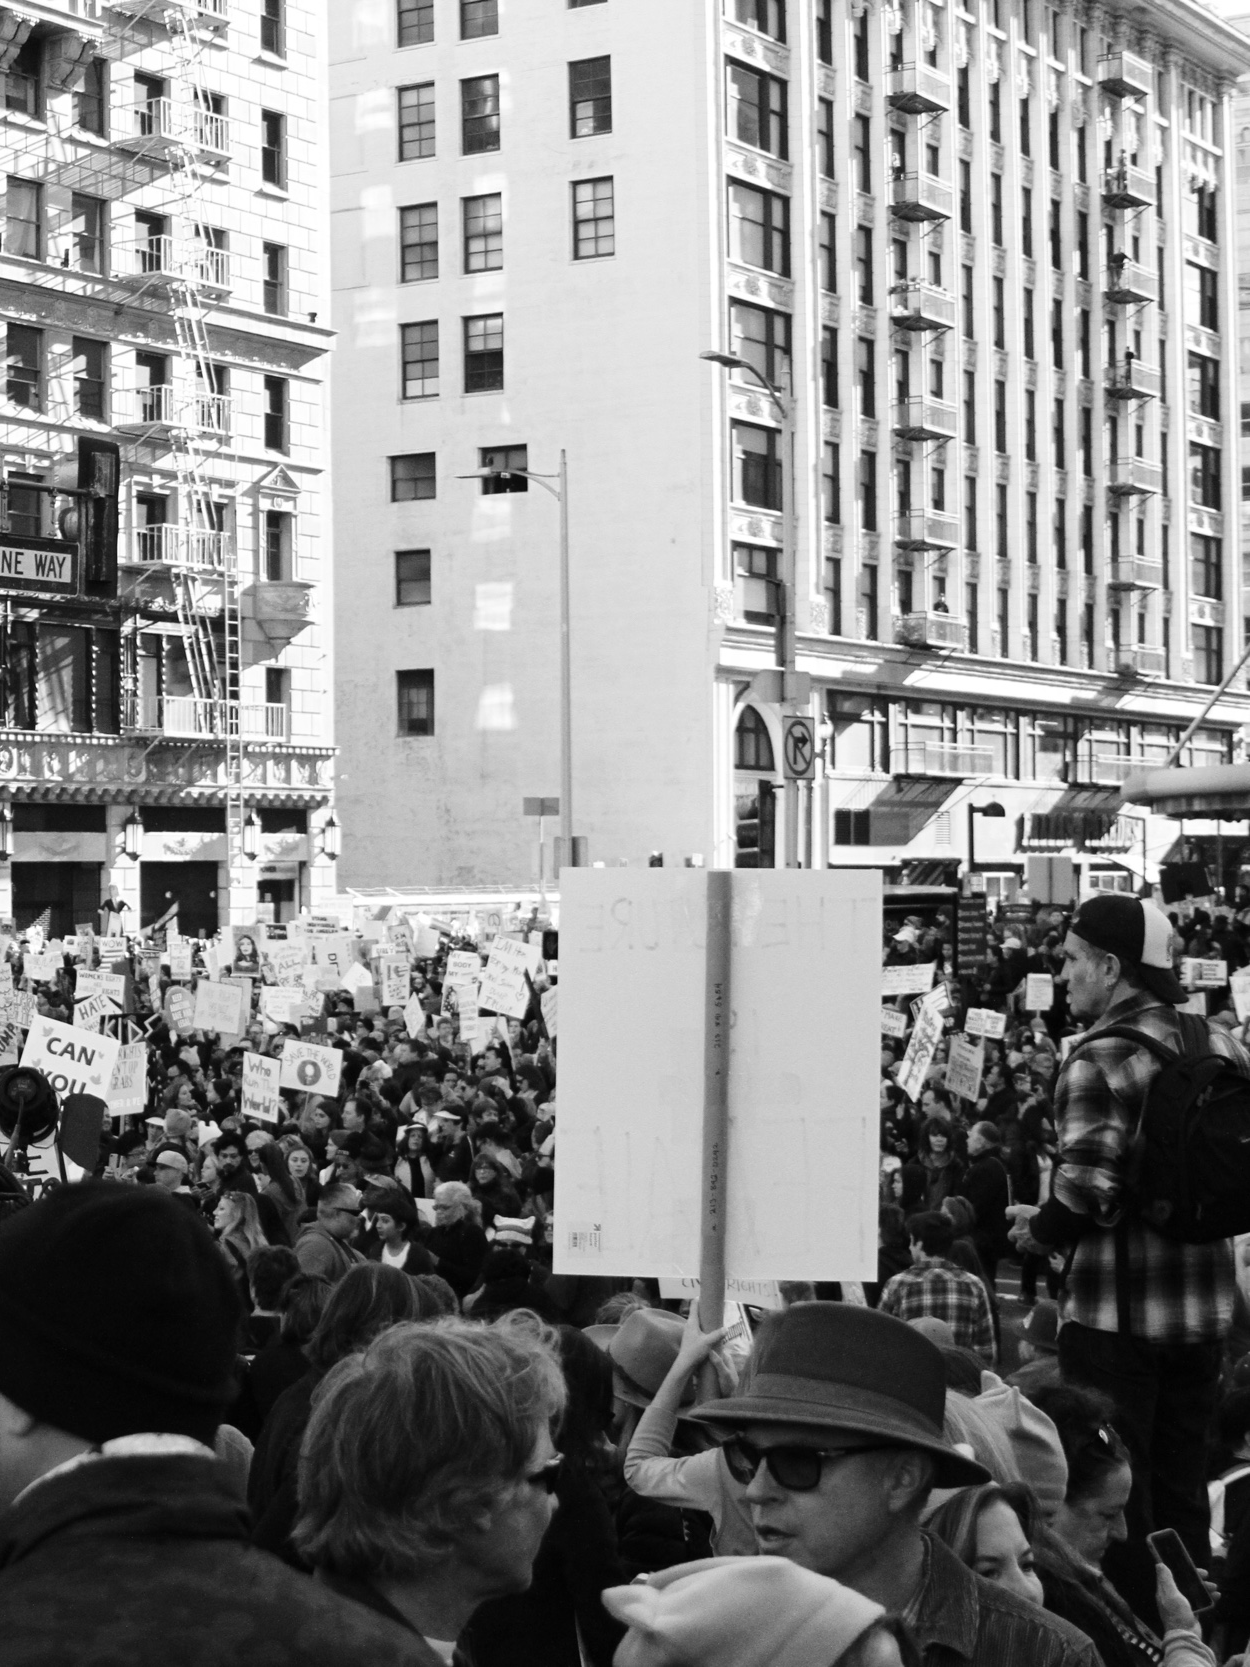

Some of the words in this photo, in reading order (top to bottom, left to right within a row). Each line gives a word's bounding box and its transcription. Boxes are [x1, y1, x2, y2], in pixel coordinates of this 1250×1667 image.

[34, 552, 67, 580] WAY
[452, 961, 472, 969] BODY
[101, 988, 121, 997] RIGHTS
[77, 994, 107, 1021] HATE
[45, 1036, 96, 1067] CAN
[284, 1047, 304, 1067] SAVE
[306, 1047, 320, 1060] THE
[320, 1053, 337, 1081] WORLD
[247, 1054, 272, 1078] Who
[38, 1067, 87, 1094] YOU
